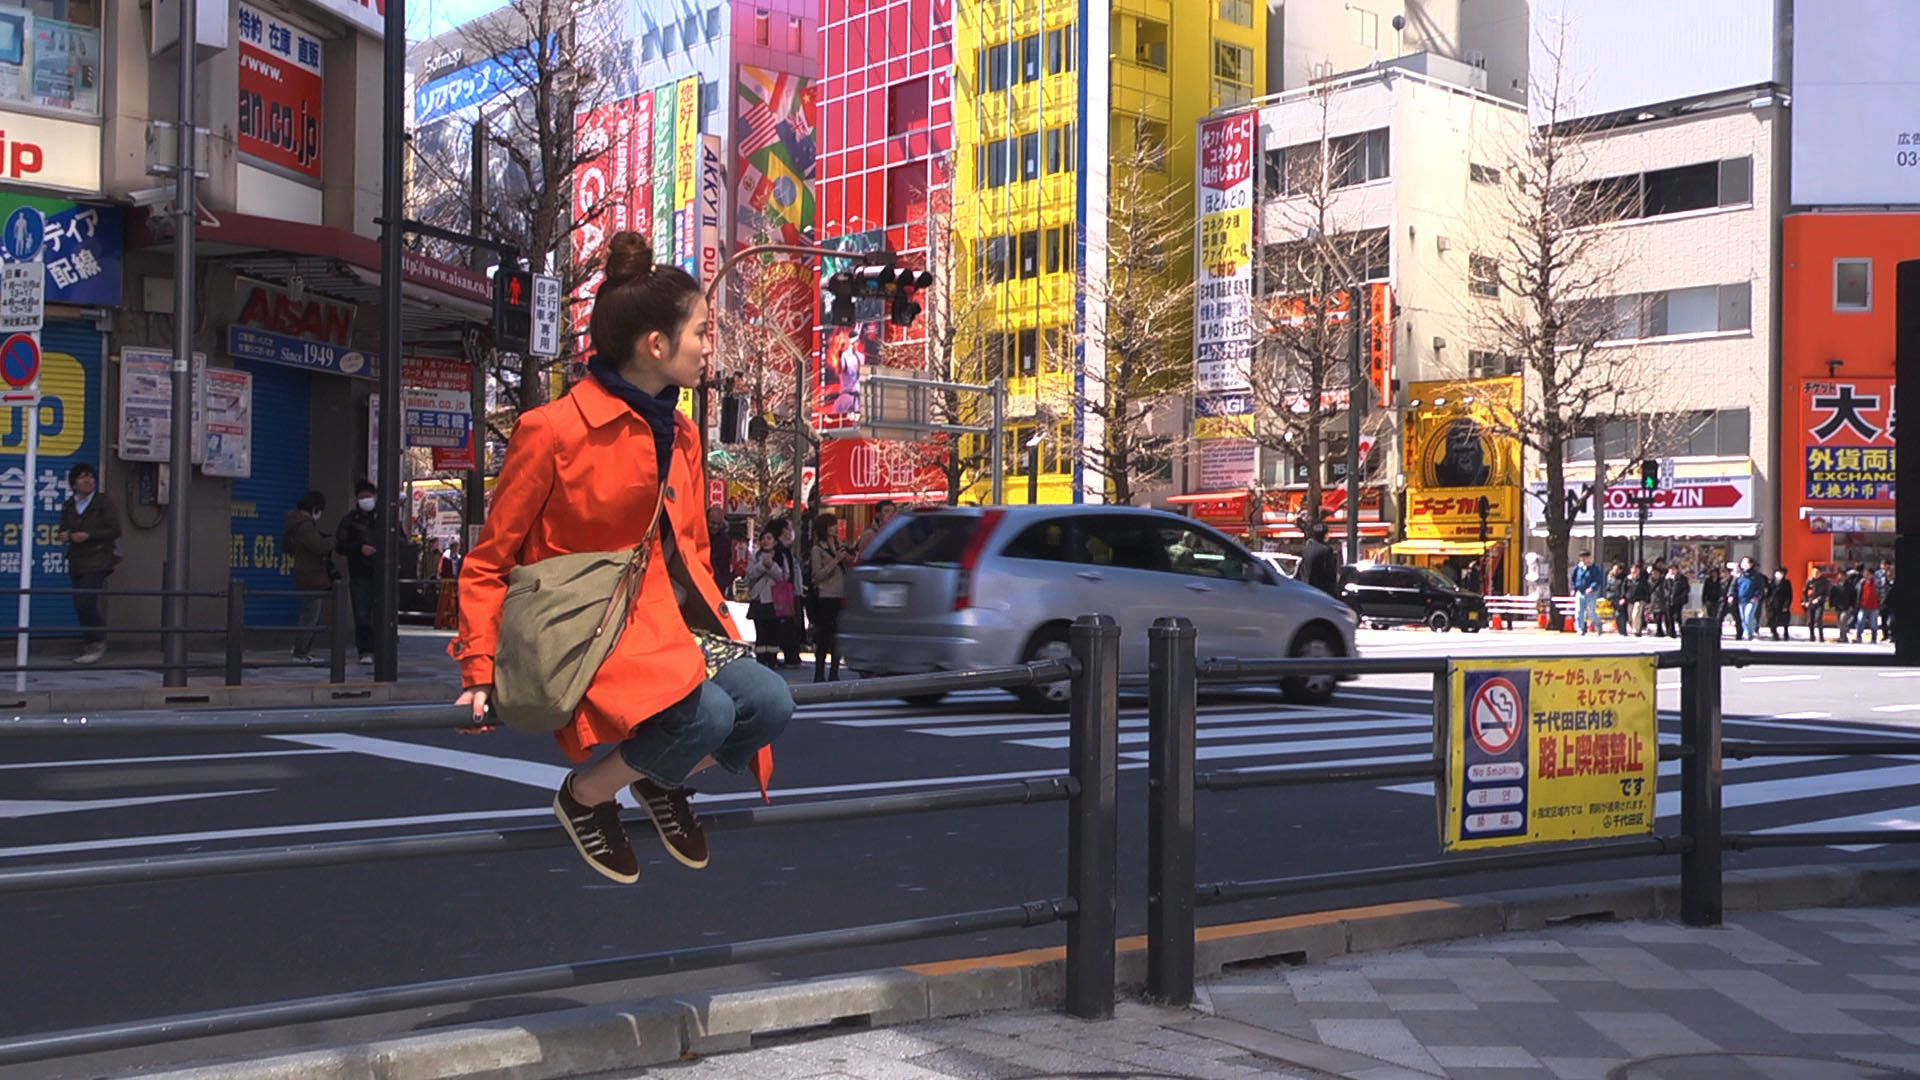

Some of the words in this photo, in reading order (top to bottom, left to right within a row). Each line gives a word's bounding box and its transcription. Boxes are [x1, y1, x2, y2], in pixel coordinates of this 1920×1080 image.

[703, 145, 719, 212] AKKY
[238, 286, 352, 348] AISAN
[304, 343, 334, 368] 1949
[1804, 381, 1836, 394] チケット
[1808, 384, 1896, 444] 大
[849, 445, 880, 488] CLUB
[1672, 488, 1704, 508] ZIN
[1577, 688, 1646, 706] そしてマナーへ
[1533, 708, 1614, 733] 千代田区内は
[1538, 731, 1644, 779] 路上喫煙禁止
[1619, 776, 1646, 797] です
